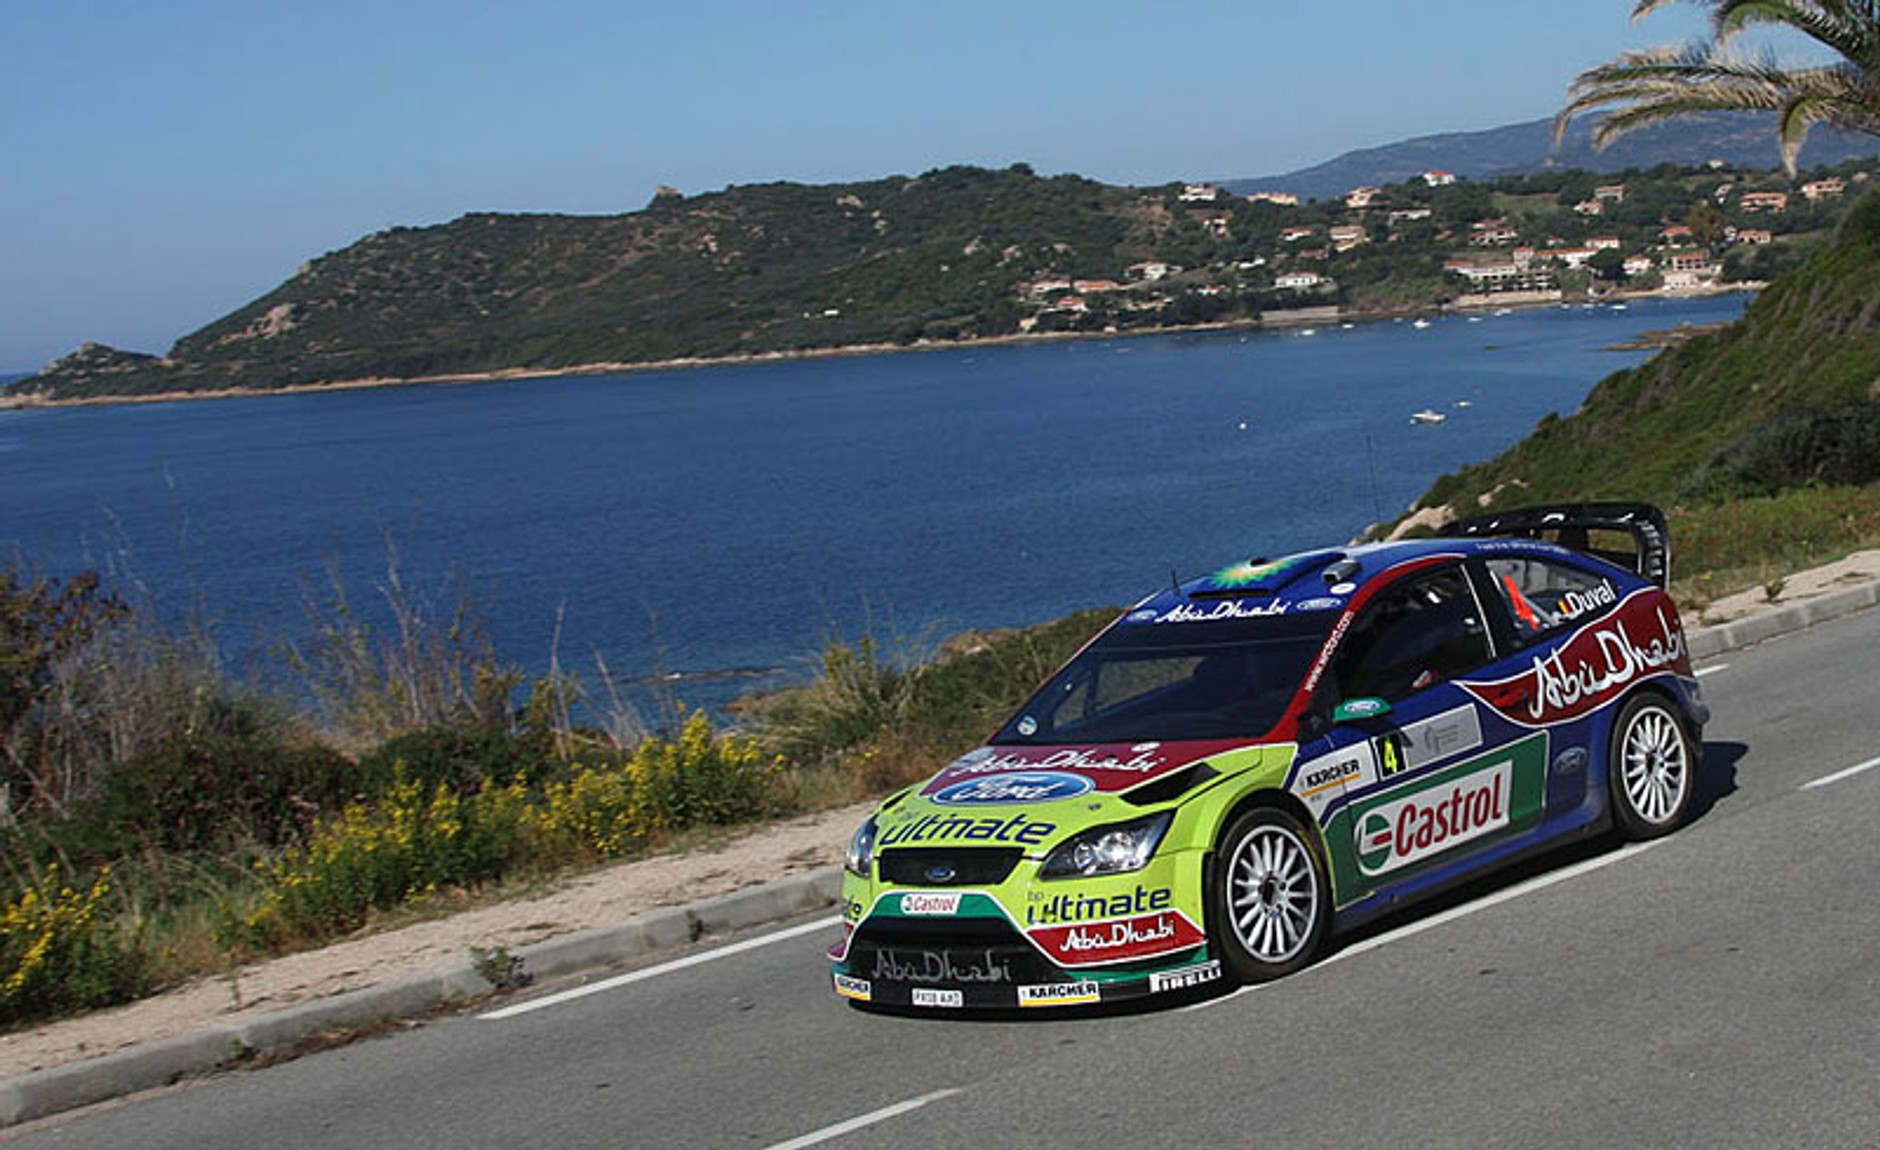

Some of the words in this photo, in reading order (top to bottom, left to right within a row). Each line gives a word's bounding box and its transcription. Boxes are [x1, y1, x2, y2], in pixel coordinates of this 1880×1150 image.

[1565, 577, 1617, 620] Duval
[1383, 735, 1399, 774] 4
[952, 776, 1068, 801] Ford
[879, 814, 1057, 846] ultimate
[1395, 773, 1502, 857] Castrol
[914, 895, 956, 911] Castrol
[1027, 884, 1172, 924] ultimate
[1149, 959, 1222, 993] PIRELLI
